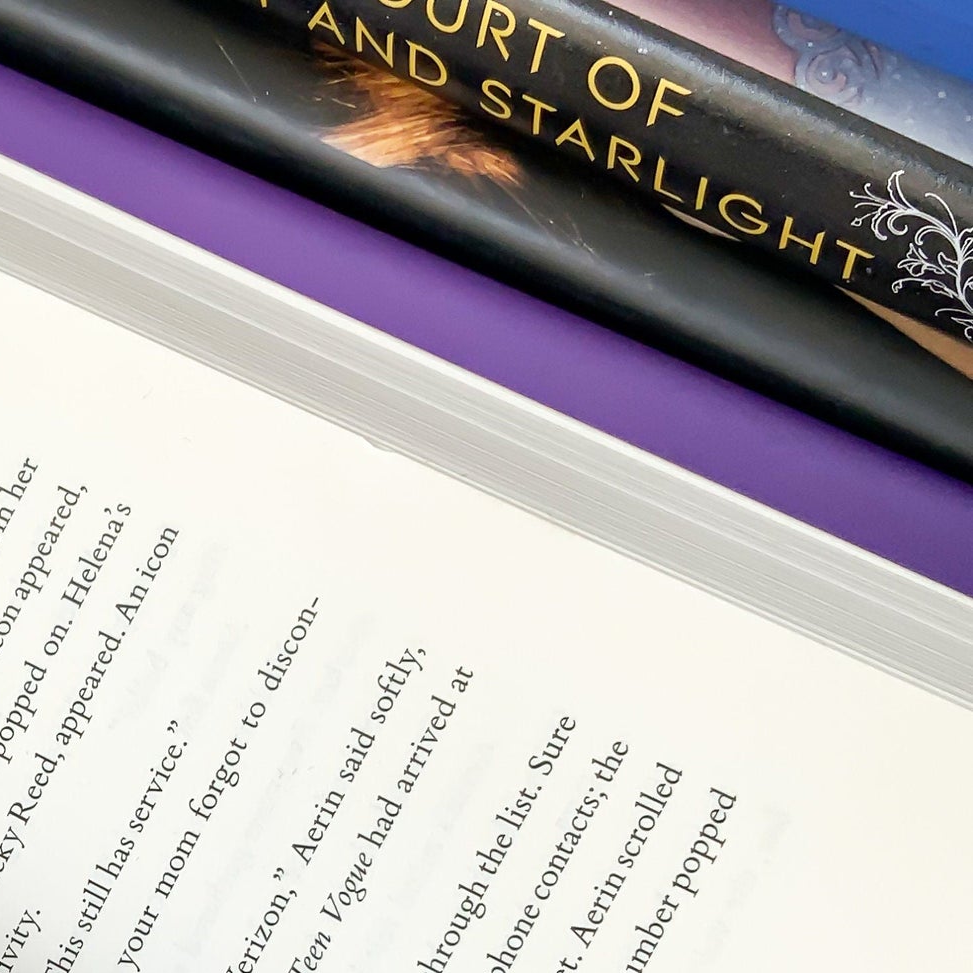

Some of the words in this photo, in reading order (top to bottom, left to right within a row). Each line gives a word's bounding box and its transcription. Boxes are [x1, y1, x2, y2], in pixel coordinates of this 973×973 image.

[308, 3, 448, 87] AND
[479, 79, 875, 280] STARLIGHT
[379, 0, 565, 74] URT
[588, 56, 693, 127] OF
[14, 484, 89, 601] appeared,
[42, 619, 73, 657] on.
[59, 502, 132, 609] Helena’s
[116, 904, 160, 973] your
[153, 830, 201, 900] mom
[187, 736, 248, 822] forgot
[240, 701, 267, 729] to
[256, 596, 319, 692] discon-
[569, 872, 627, 950] Aerin
[616, 761, 683, 869] scrolled
